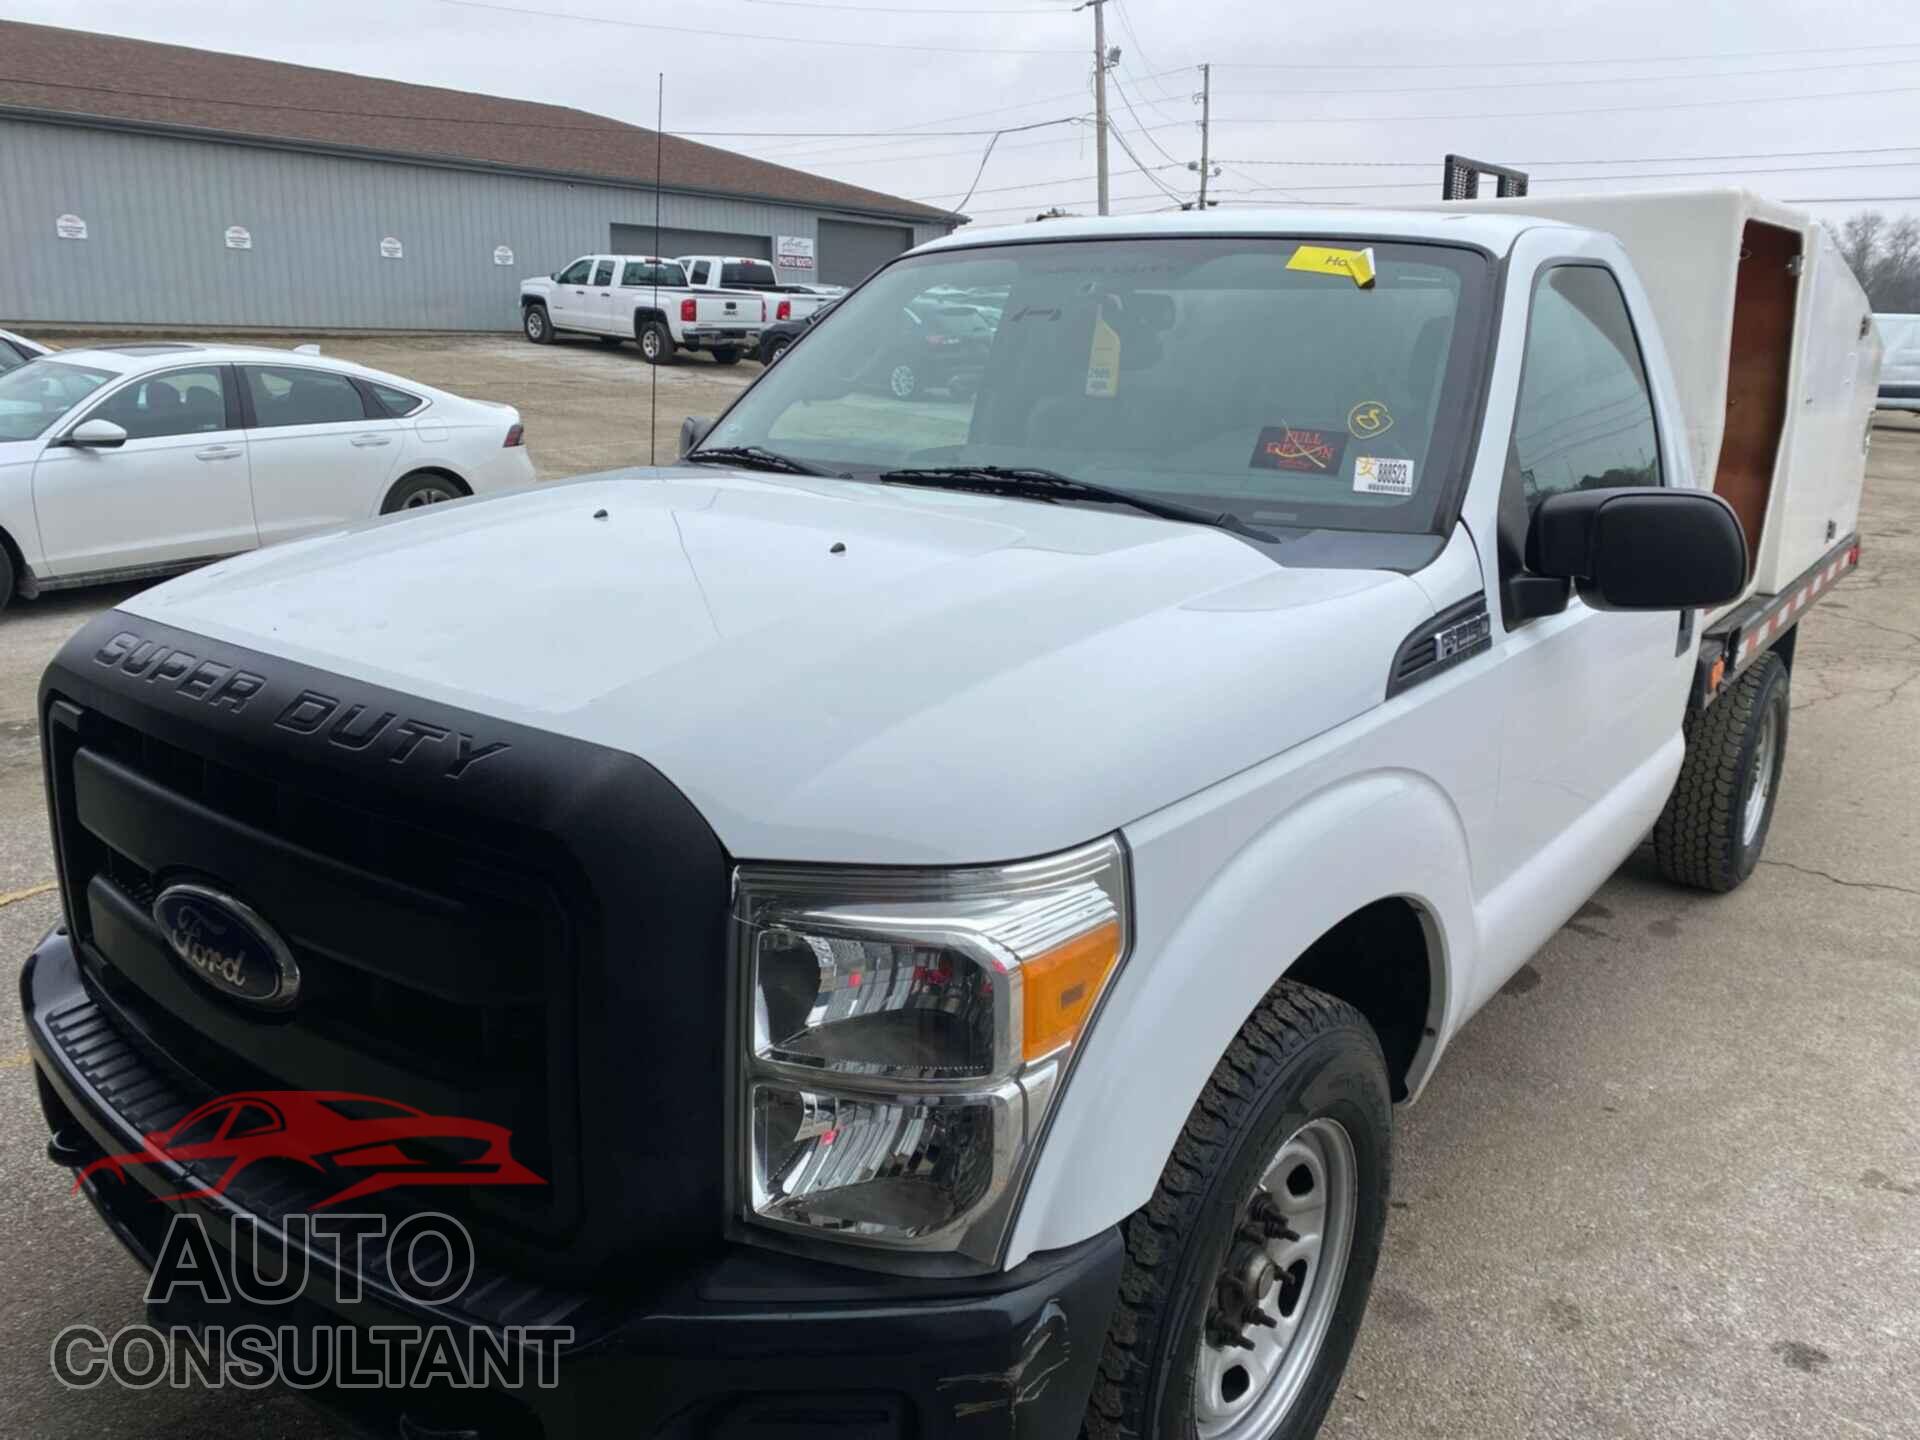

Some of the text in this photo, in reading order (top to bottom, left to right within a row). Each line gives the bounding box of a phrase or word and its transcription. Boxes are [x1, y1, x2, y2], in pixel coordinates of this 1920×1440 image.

[94, 630, 512, 780] SUPER DUTY
[173, 906, 246, 986] Ford
